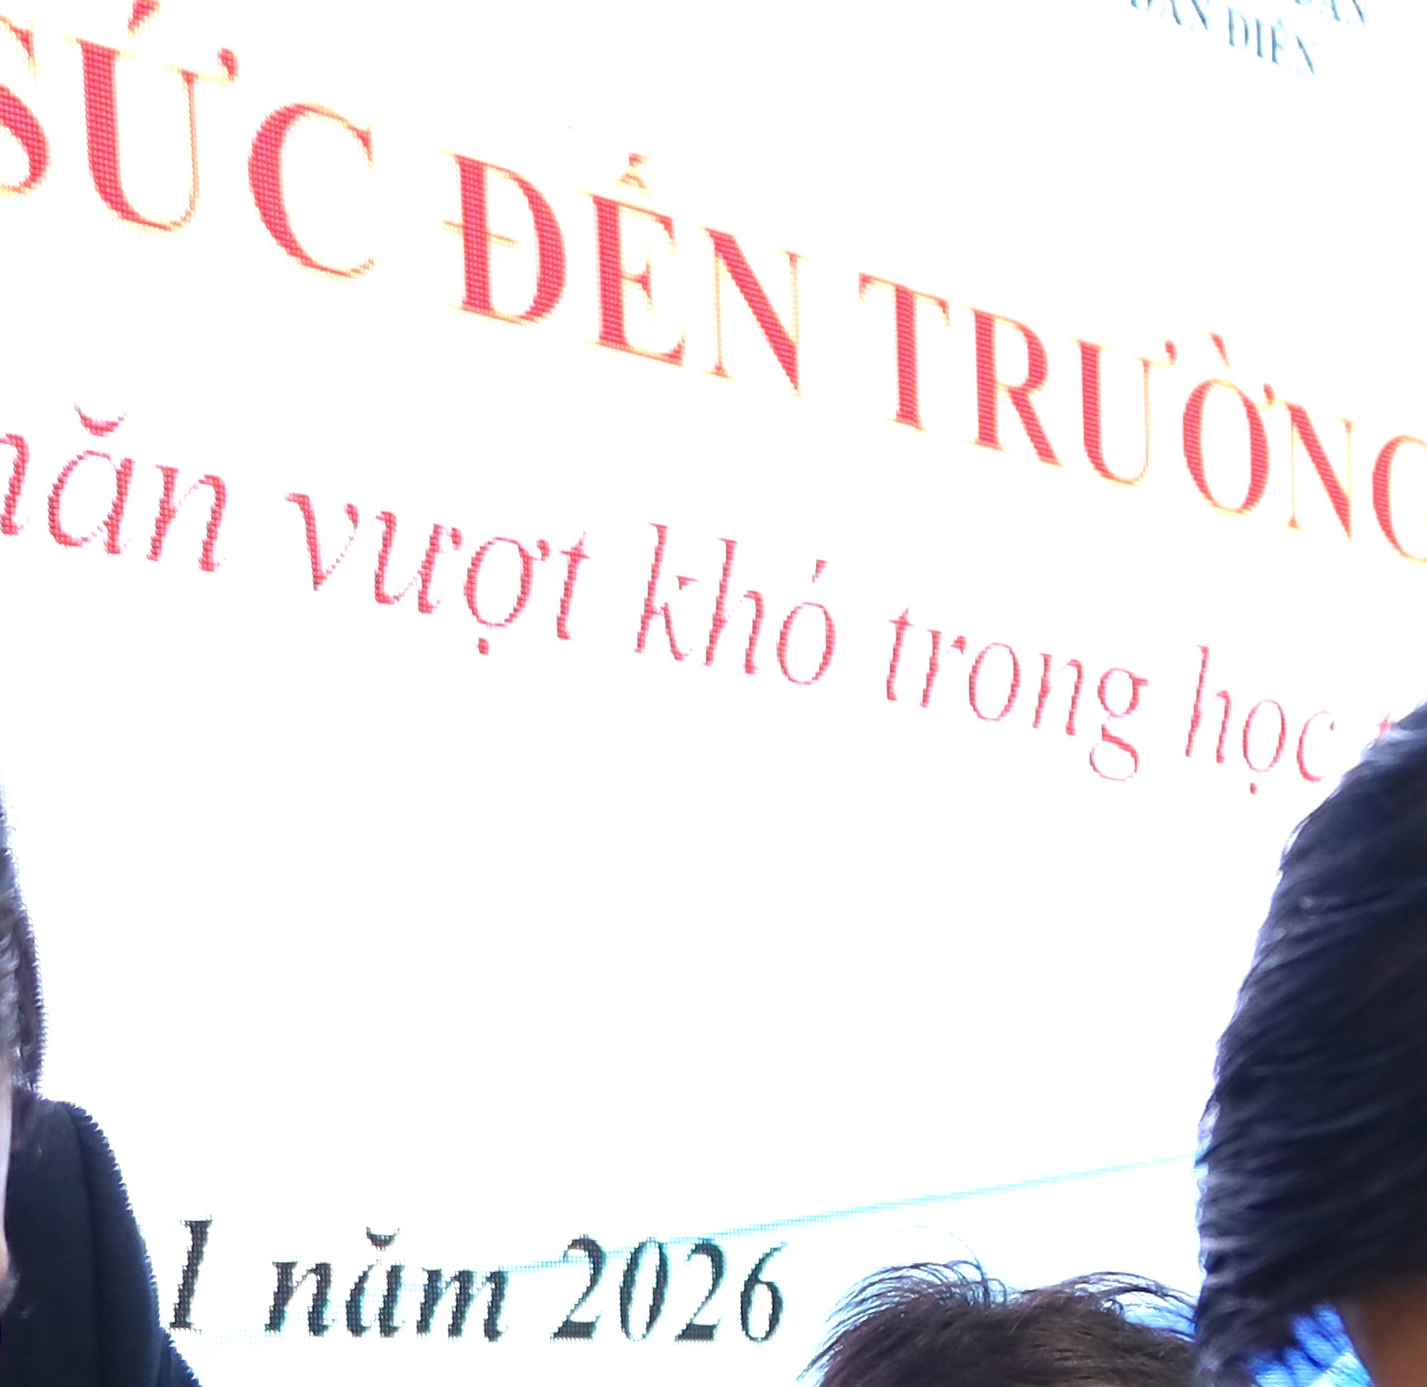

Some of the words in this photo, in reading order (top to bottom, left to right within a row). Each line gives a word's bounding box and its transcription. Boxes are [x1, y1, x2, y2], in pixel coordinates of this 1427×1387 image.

[443, 152, 805, 396] ĐẾN
[284, 489, 591, 656] vượt
[633, 522, 838, 688] khó
[886, 600, 1151, 783] trong
[1184, 643, 1337, 796] học
[264, 1226, 511, 1343] năm
[549, 1232, 790, 1343] 2026
